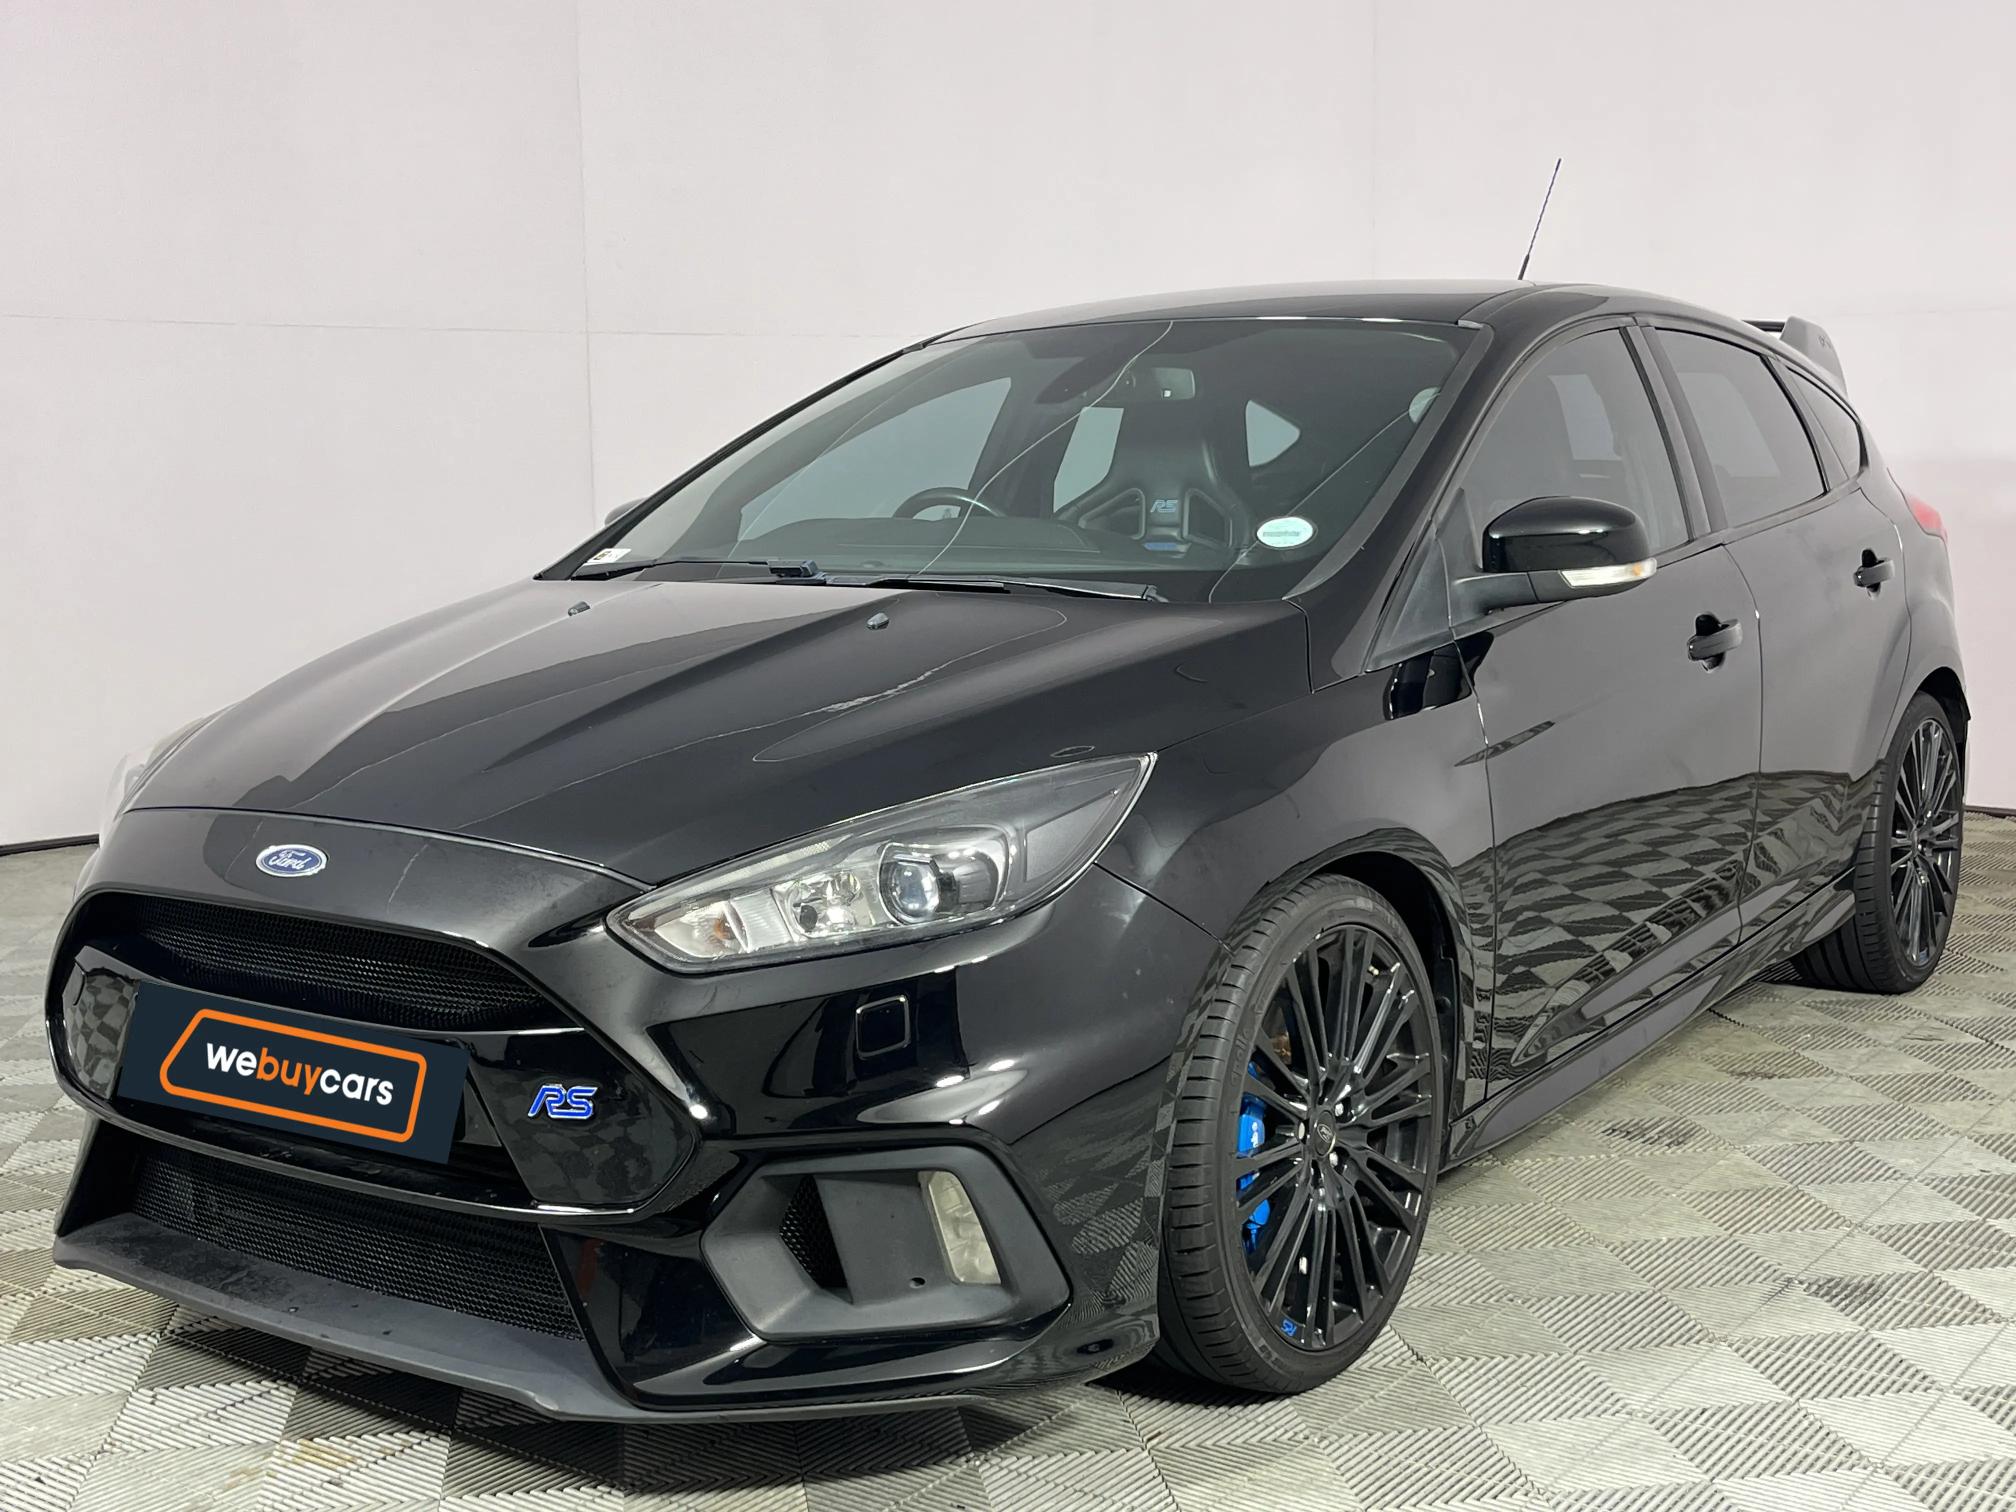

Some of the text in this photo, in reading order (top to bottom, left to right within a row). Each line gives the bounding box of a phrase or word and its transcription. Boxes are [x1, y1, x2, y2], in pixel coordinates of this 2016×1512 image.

[1150, 499, 1179, 513] RS
[267, 849, 312, 870] Ford
[528, 1083, 598, 1119] RS
